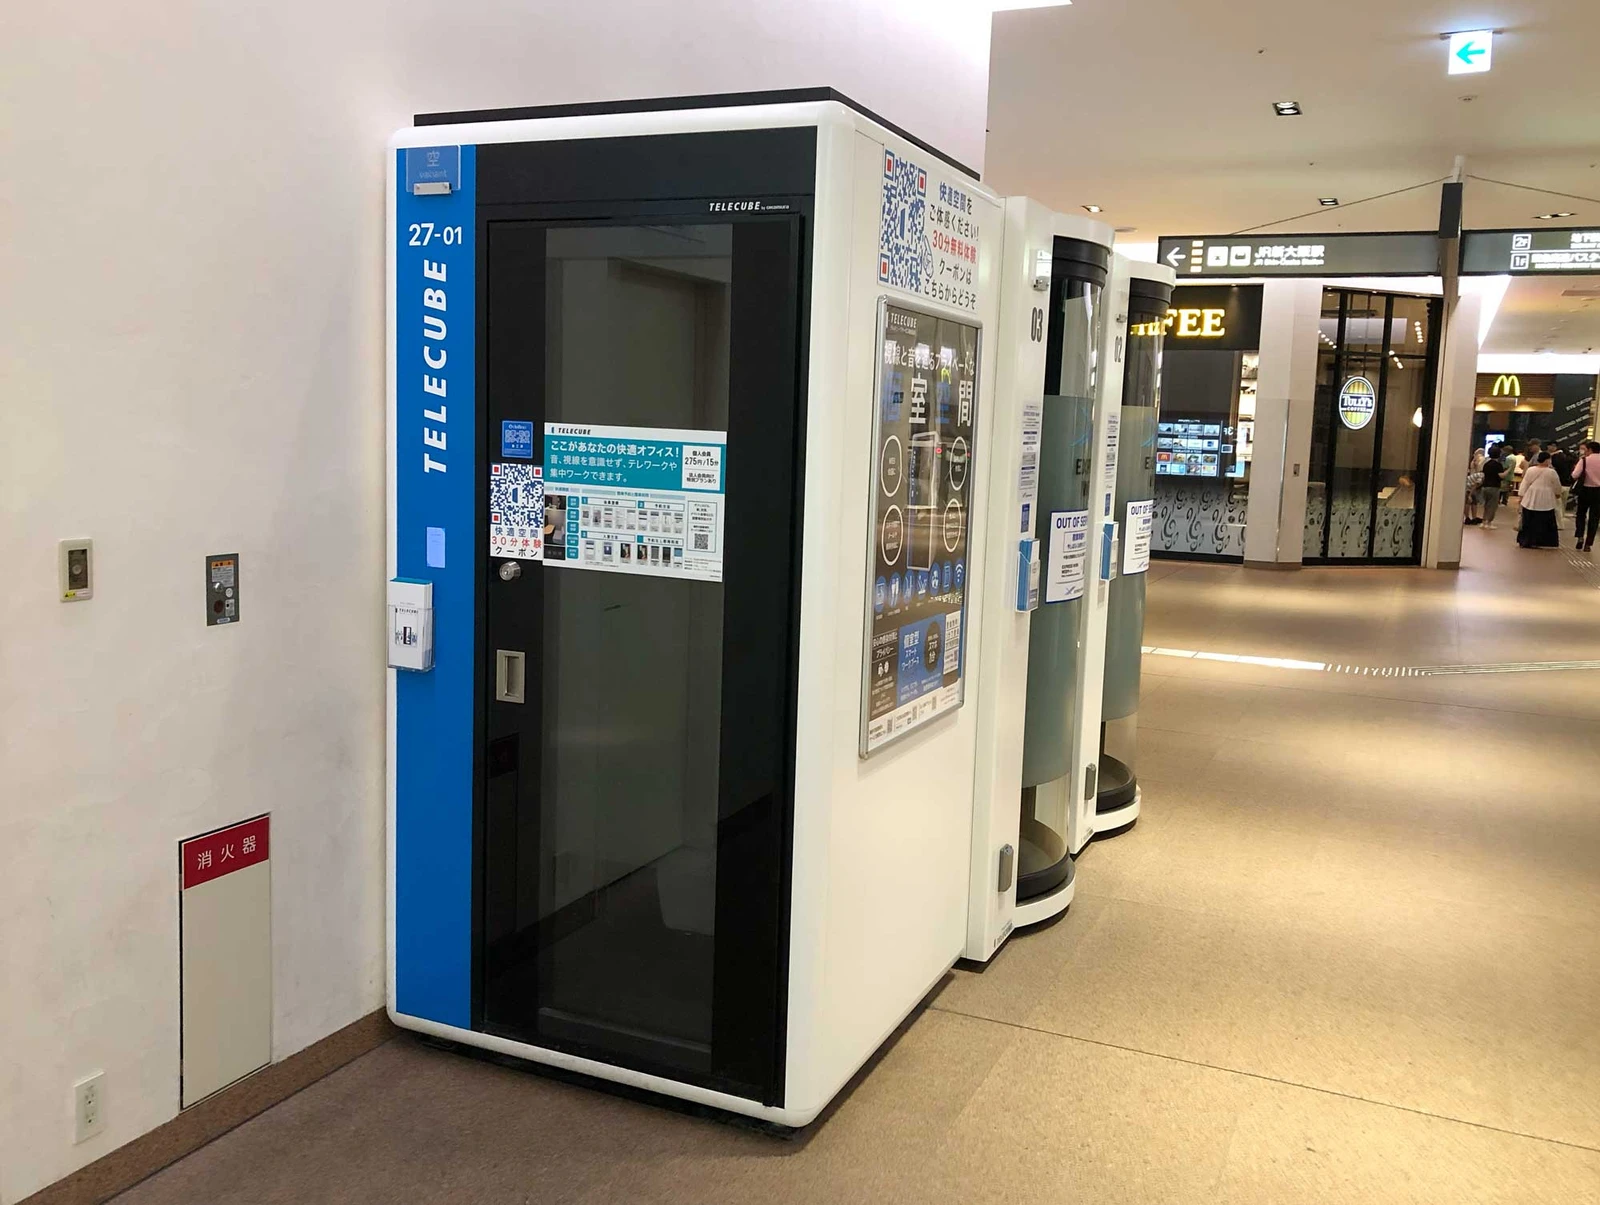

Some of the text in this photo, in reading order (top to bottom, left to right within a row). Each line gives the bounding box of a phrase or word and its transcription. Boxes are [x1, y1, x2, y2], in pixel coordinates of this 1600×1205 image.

[426, 150, 441, 167] 空
[709, 201, 761, 212] TELECUBE
[939, 181, 973, 216] 快適空間を
[408, 222, 462, 246] 27-01
[932, 229, 977, 265] 30分無料体験
[939, 257, 972, 286] クーポンは
[890, 312, 918, 329] TELECUBE
[1030, 306, 1044, 343] 03
[1114, 335, 1123, 363] 02
[423, 259, 448, 474] TELECUBE
[558, 427, 592, 436] TELECUBE
[550, 440, 679, 458] ここがあなたの快適オフィス!
[549, 454, 678, 471] 音、視線を意識せず、テレワークや
[549, 467, 628, 483] 集中ワークできます。
[1130, 505, 1142, 516] OUT
[1056, 517, 1072, 529] OUT
[1072, 515, 1080, 528] OF
[494, 526, 539, 539] 快適空間
[491, 536, 542, 549] 30分体験
[494, 545, 539, 558] クーポン
[197, 834, 257, 871] 消火器
